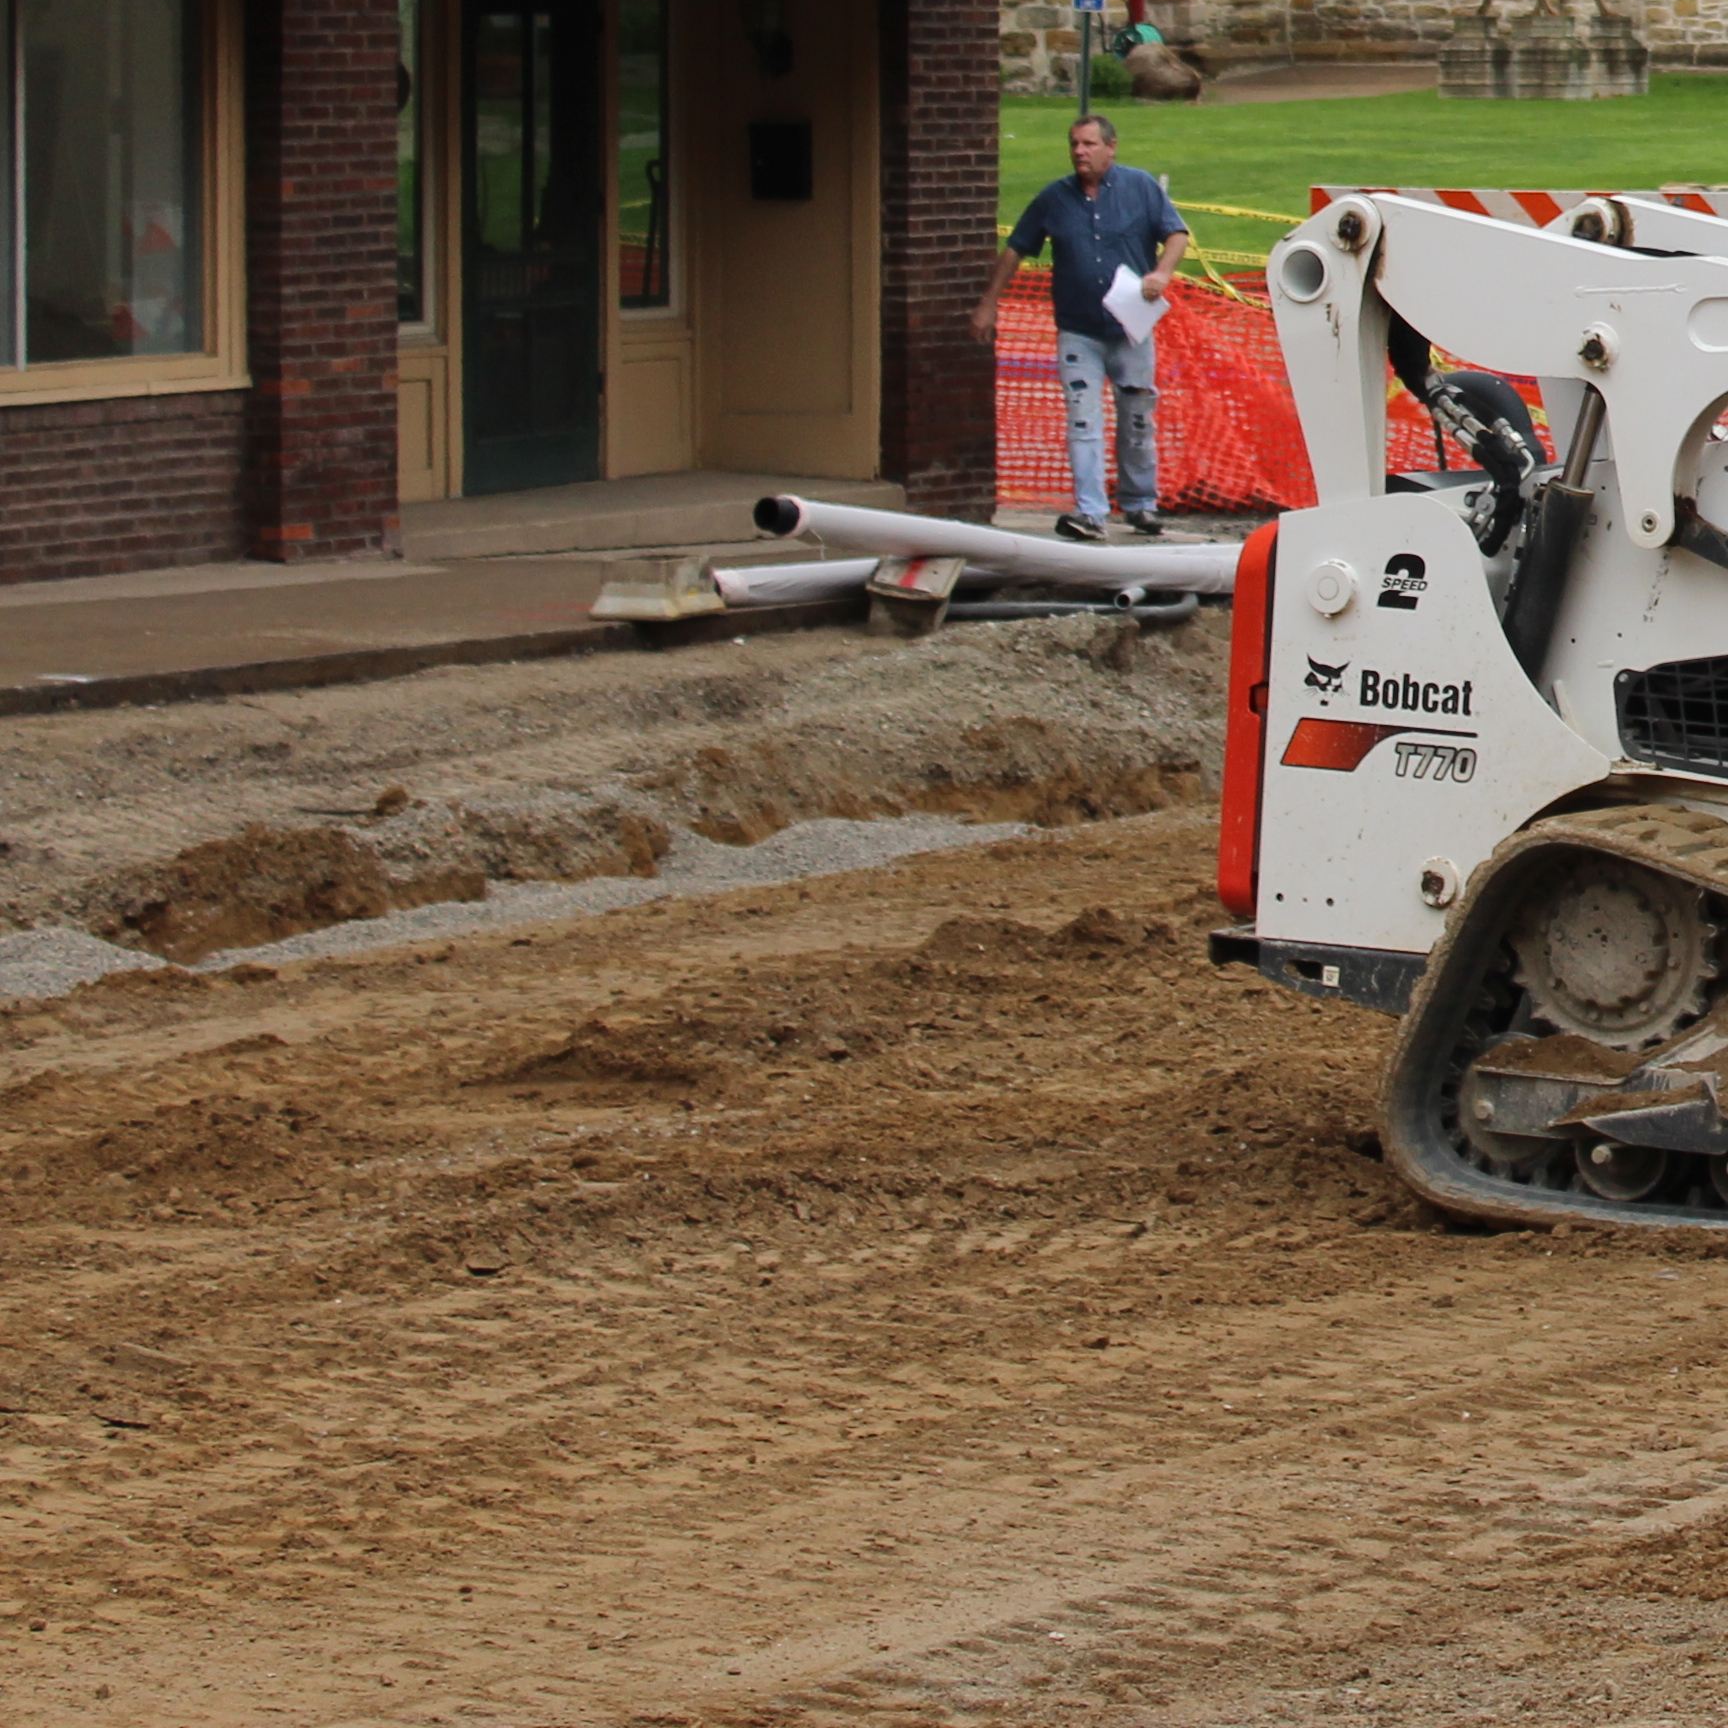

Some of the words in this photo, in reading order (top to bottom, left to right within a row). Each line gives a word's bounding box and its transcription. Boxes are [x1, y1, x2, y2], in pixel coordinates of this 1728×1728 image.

[1377, 553, 1426, 610] 2
[1381, 576, 1428, 592] SPEED
[1360, 669, 1473, 716] Bobcat
[1395, 742, 1477, 783] T770
